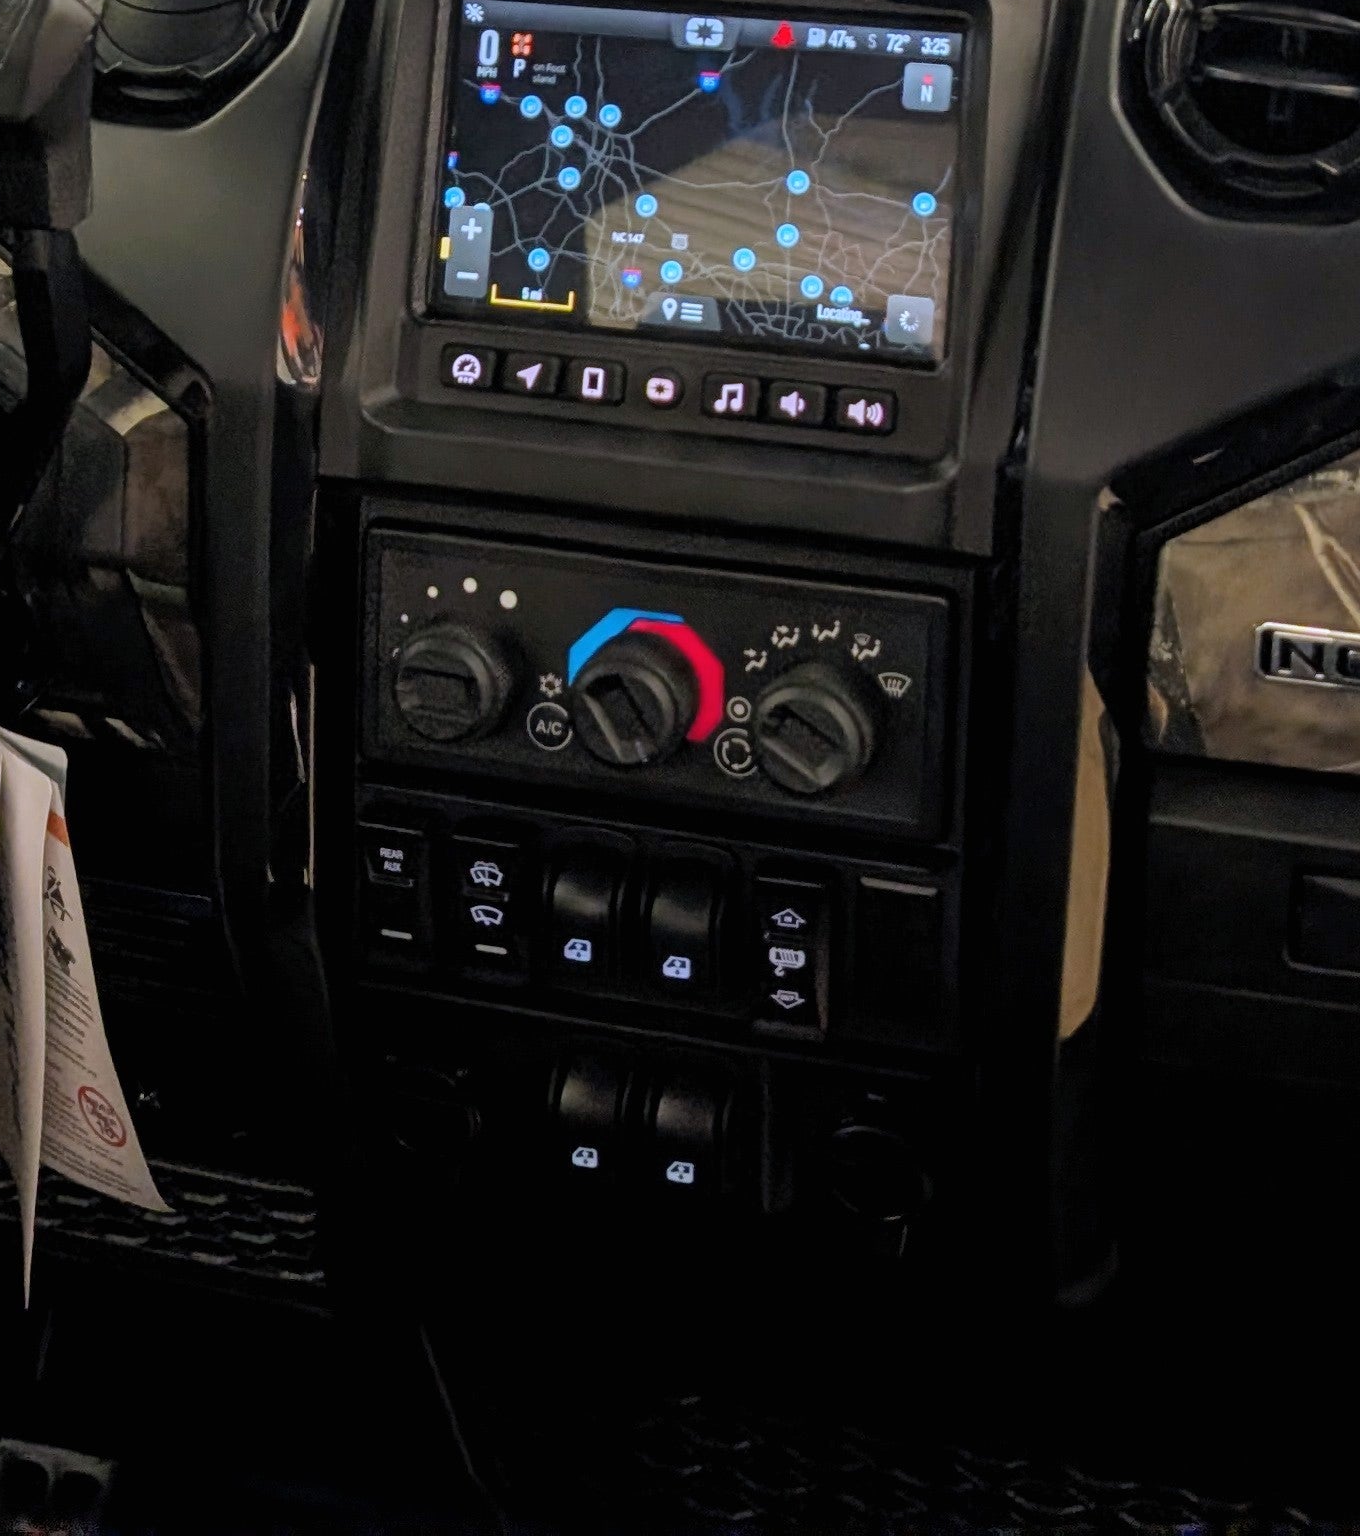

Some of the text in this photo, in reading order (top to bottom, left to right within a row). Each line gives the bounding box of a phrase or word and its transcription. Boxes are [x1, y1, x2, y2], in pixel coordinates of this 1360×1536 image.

[478, 29, 500, 66] 0
[512, 58, 527, 79] P
[920, 84, 934, 103] N
[535, 719, 562, 736] A/C
